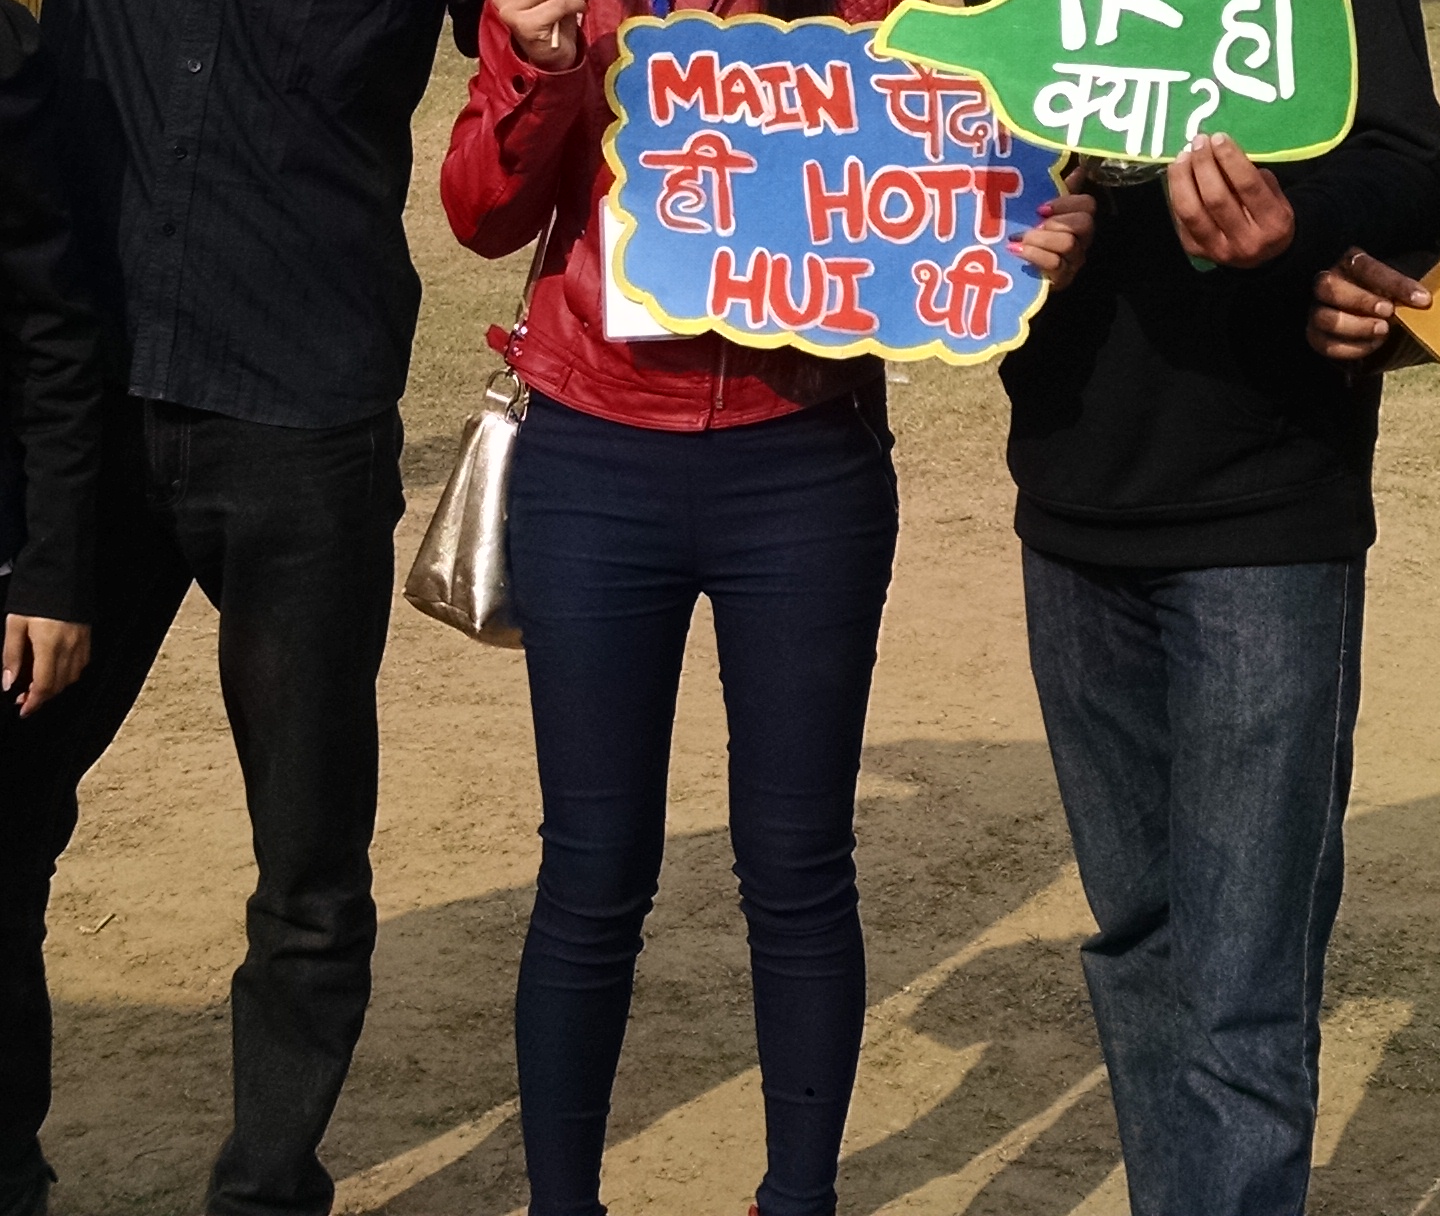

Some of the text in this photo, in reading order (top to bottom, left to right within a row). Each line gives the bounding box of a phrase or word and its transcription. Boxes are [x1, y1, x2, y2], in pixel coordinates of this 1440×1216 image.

[646, 50, 859, 137] MAIN
[639, 129, 1024, 246] ही HOTT
[706, 245, 880, 334] HUI
